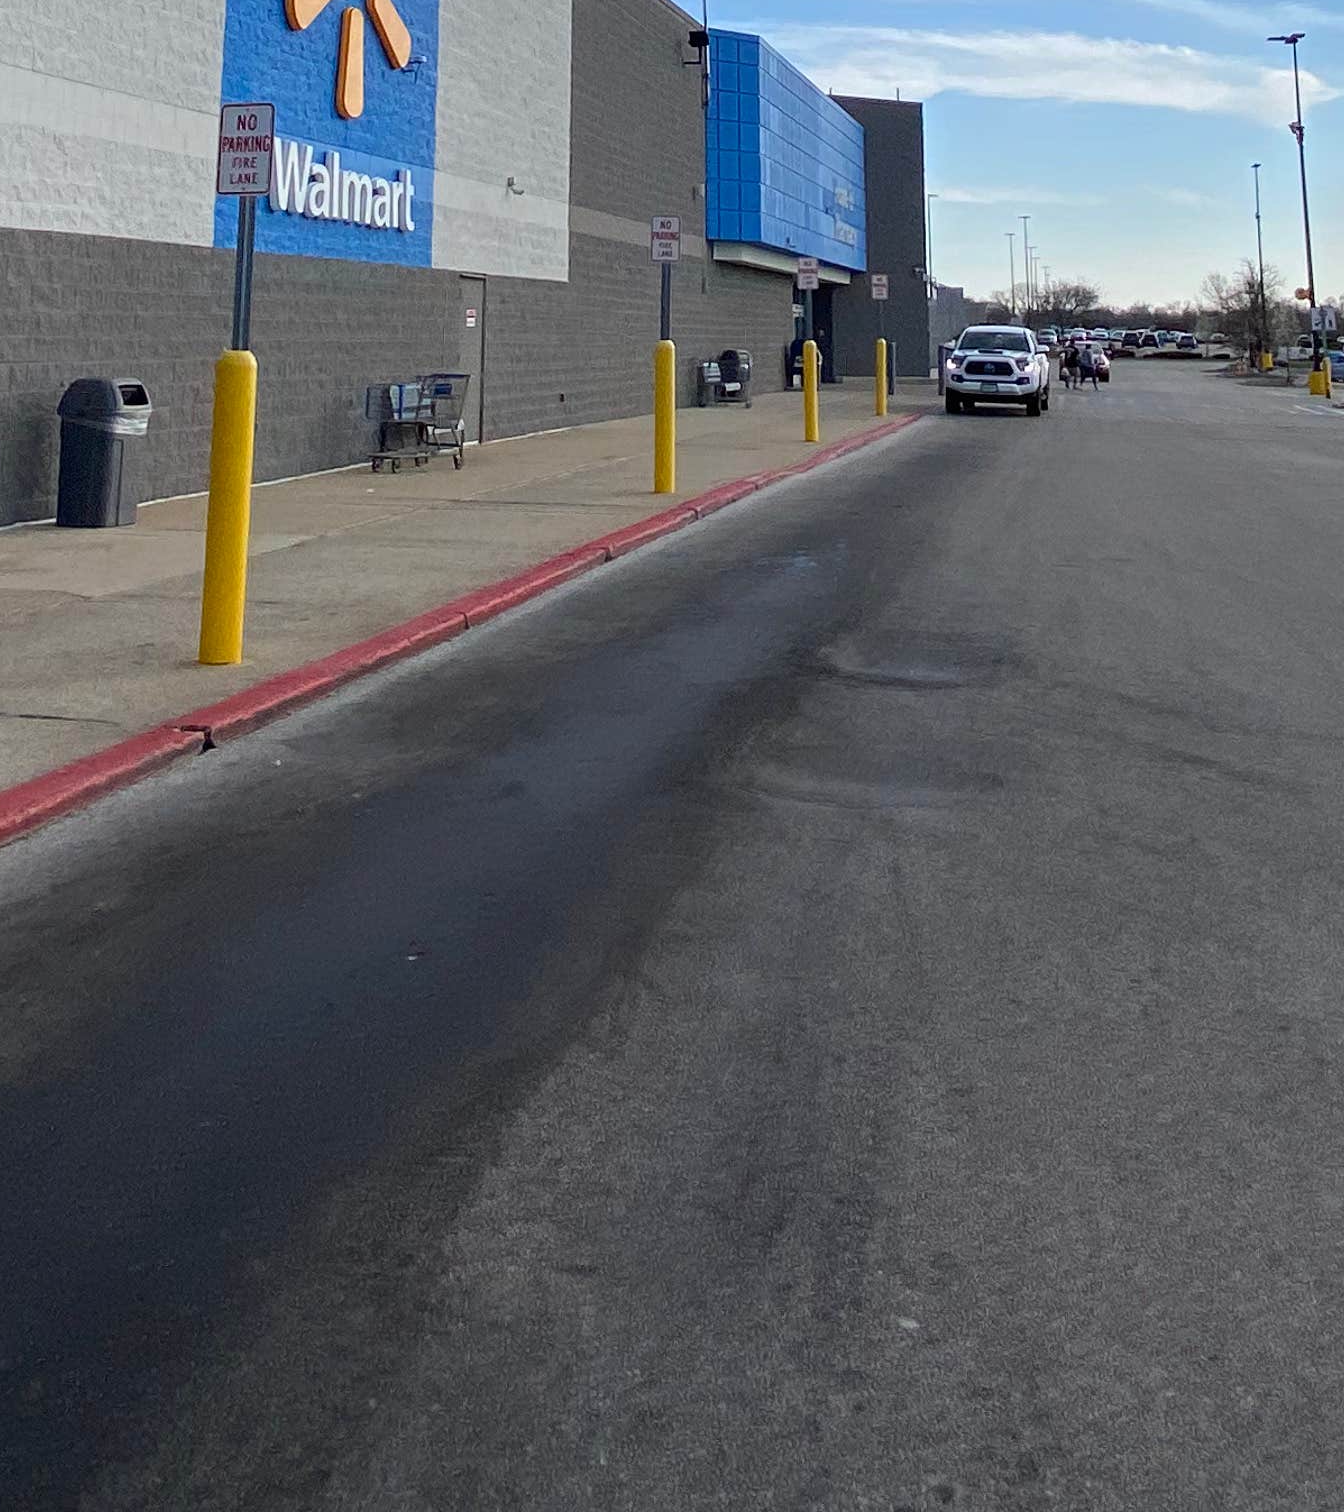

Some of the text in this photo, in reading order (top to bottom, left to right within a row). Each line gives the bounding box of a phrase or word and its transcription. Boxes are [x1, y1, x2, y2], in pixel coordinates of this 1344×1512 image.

[237, 114, 258, 131] NO
[221, 135, 272, 153] PARKING
[232, 157, 258, 169] FIRE
[229, 173, 259, 185] LANE
[270, 136, 416, 232] Walmart
